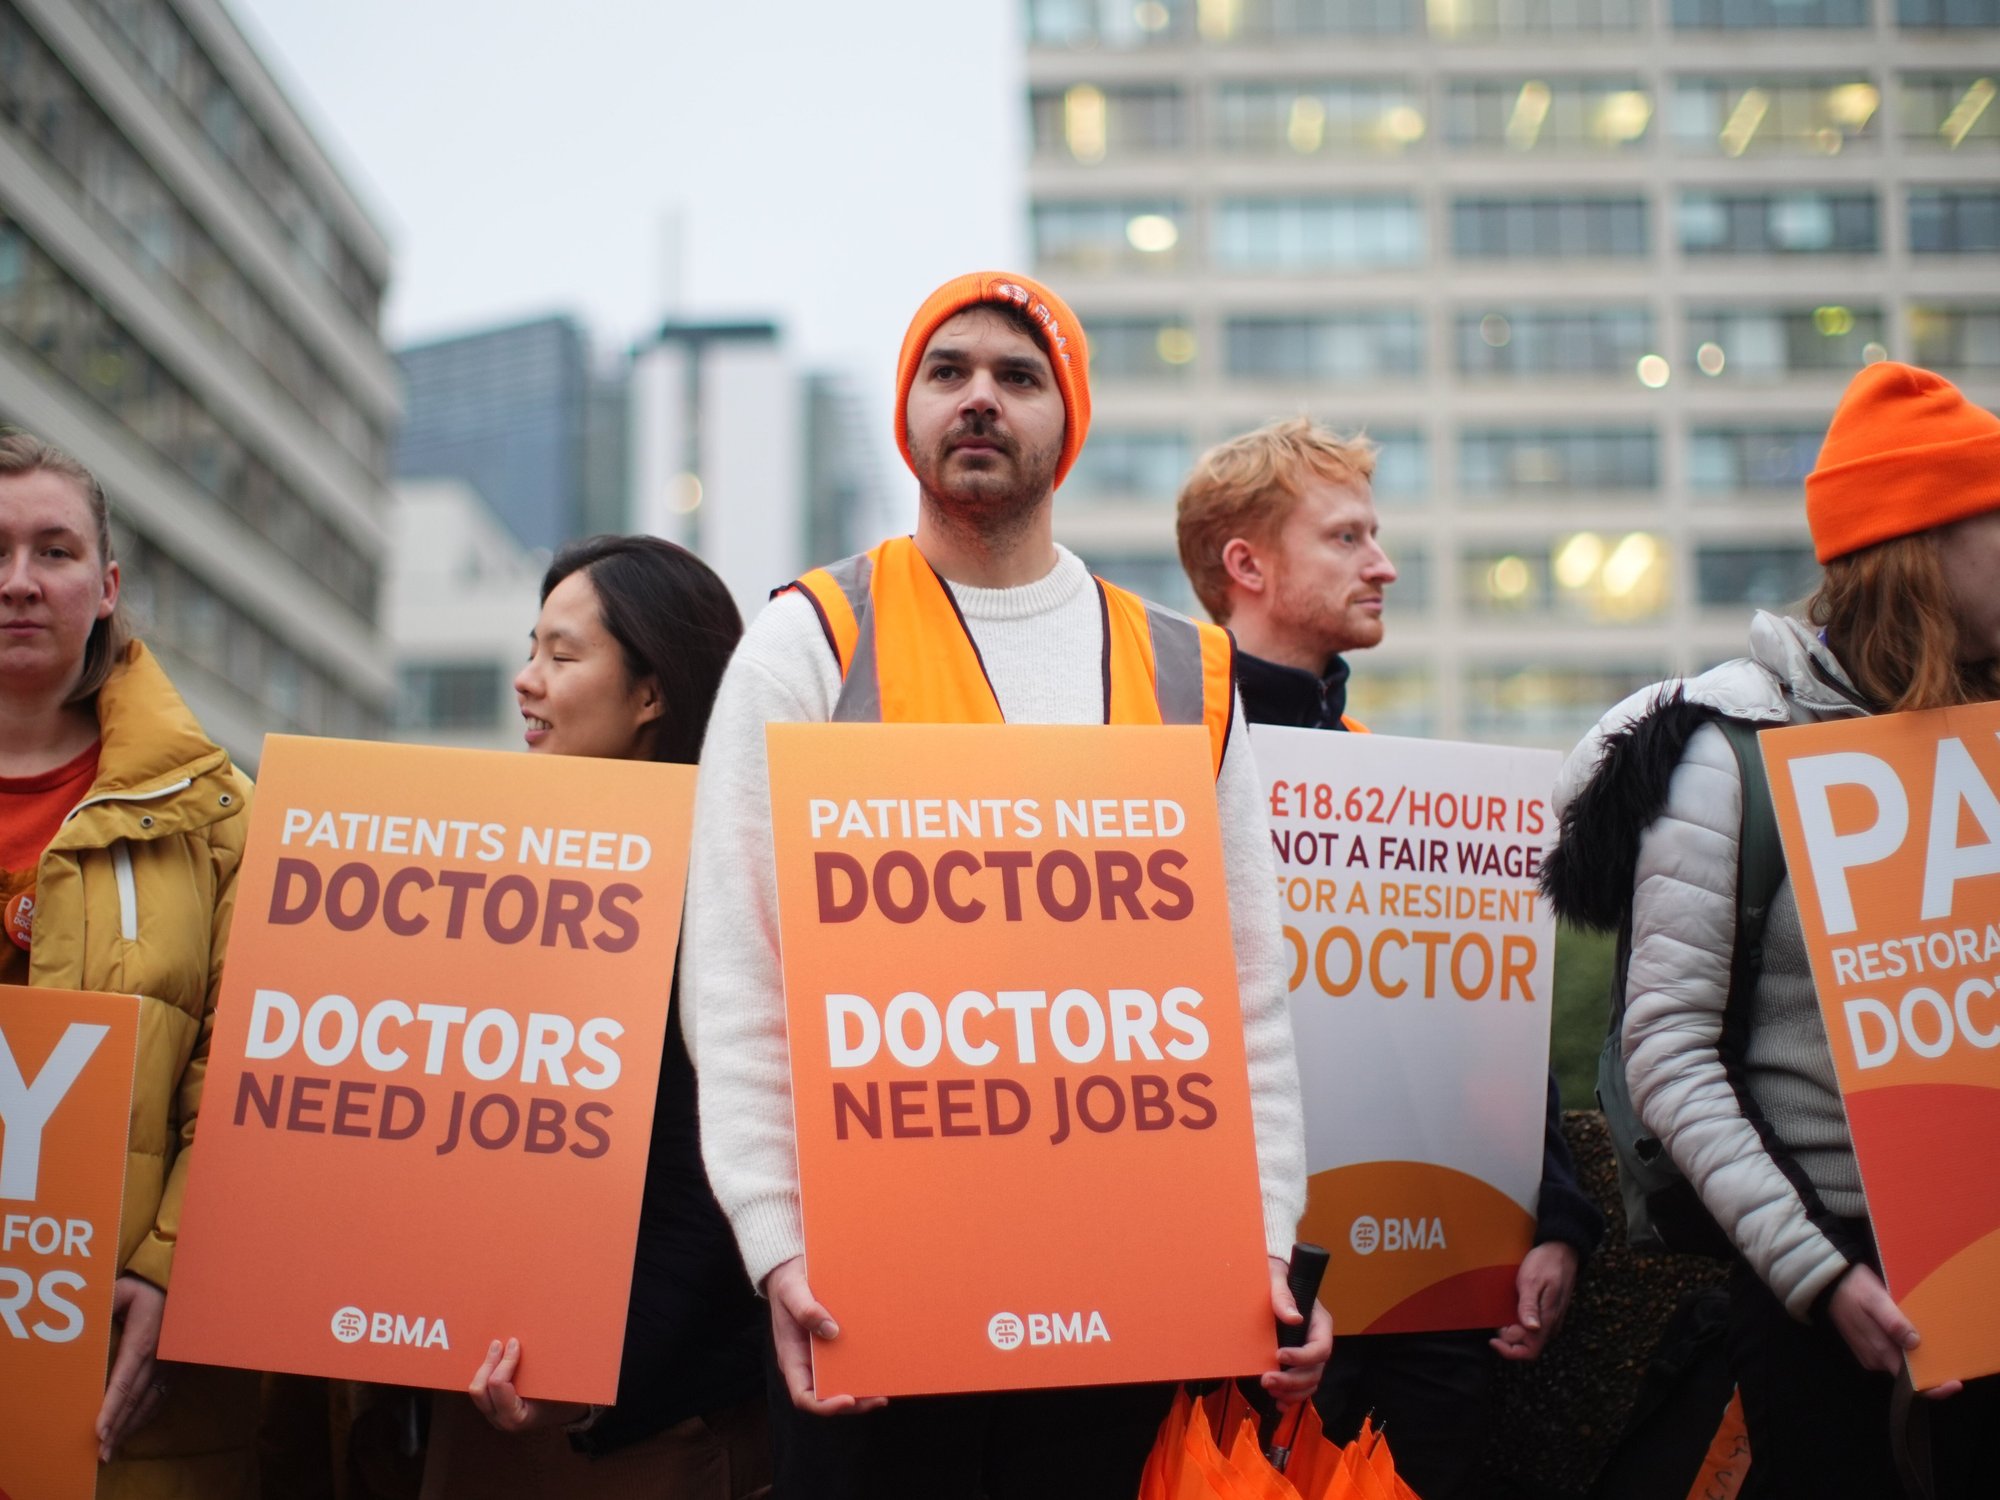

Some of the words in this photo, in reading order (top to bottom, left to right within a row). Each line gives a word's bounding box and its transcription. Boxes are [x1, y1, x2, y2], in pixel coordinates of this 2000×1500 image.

[808, 798, 1043, 838] PATIENTS
[1054, 799, 1186, 838] NEED
[1269, 780, 1507, 832] £18.62/HOUR
[1516, 798, 1545, 835] IS
[1787, 731, 2000, 936] PA
[281, 808, 507, 862] PATIENTS
[517, 826, 652, 872] NEED
[1270, 829, 1339, 866] NOT
[1346, 835, 1369, 868] A
[1379, 836, 1448, 873] FAIR
[1457, 841, 1543, 879] WAGE
[267, 856, 643, 954] DOCTORS
[814, 848, 1195, 924] DOCTORS
[1345, 880, 1369, 915] A
[1379, 883, 1540, 923] RESIDENT
[1831, 923, 2000, 986] RESTORA
[244, 988, 626, 1090] DOCTORS
[825, 986, 1210, 1068] DOCTORS
[1843, 976, 2000, 1071] DOC
[232, 1070, 426, 1141] NEED
[435, 1090, 614, 1159] JOBS
[832, 1078, 1032, 1140] NEED
[1049, 1072, 1218, 1146] JOBS
[2, 1214, 94, 1258] FOR
[1383, 1216, 1447, 1251] BMA
[369, 1312, 449, 1350] BMA
[1028, 1311, 1111, 1345] BMA
